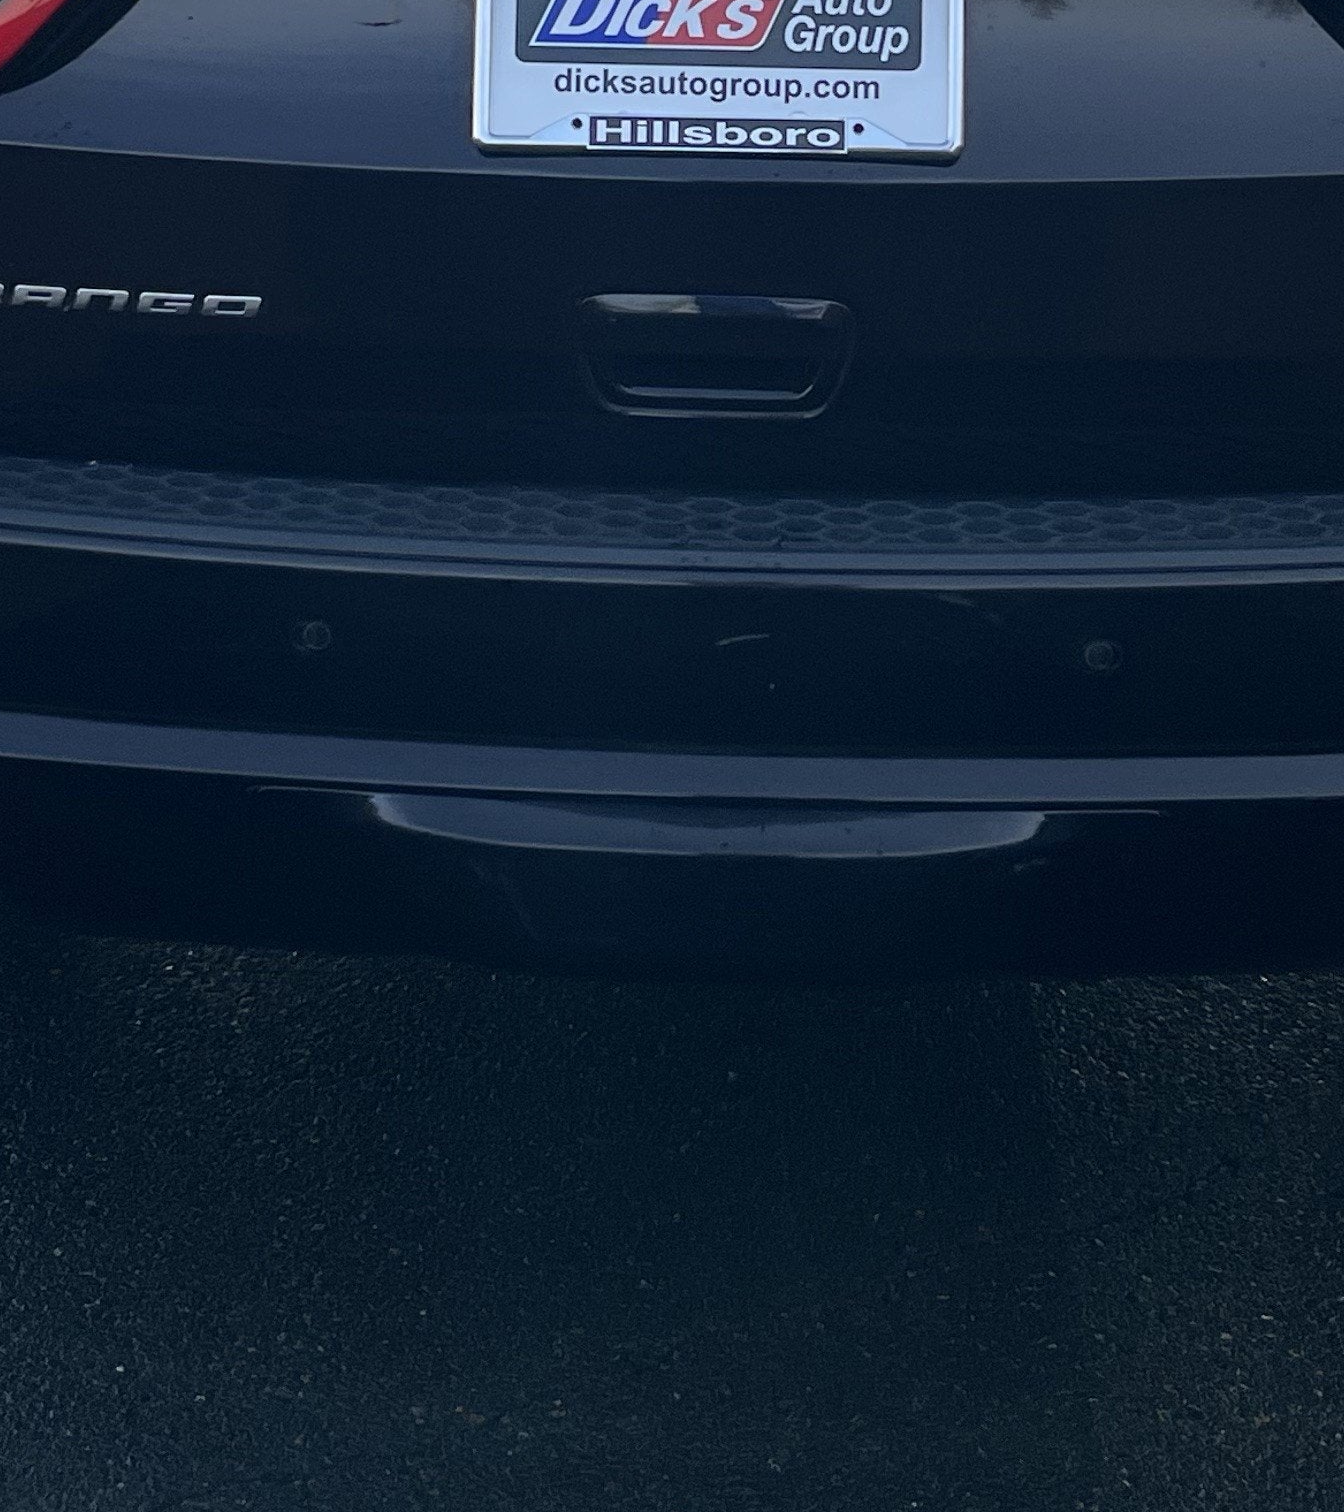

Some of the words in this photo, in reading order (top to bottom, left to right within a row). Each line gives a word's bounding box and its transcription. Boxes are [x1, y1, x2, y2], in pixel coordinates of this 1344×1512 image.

[784, 14, 909, 61] Group
[554, 68, 880, 103] dicksautogroup.com
[595, 119, 841, 147] Hillsboro
